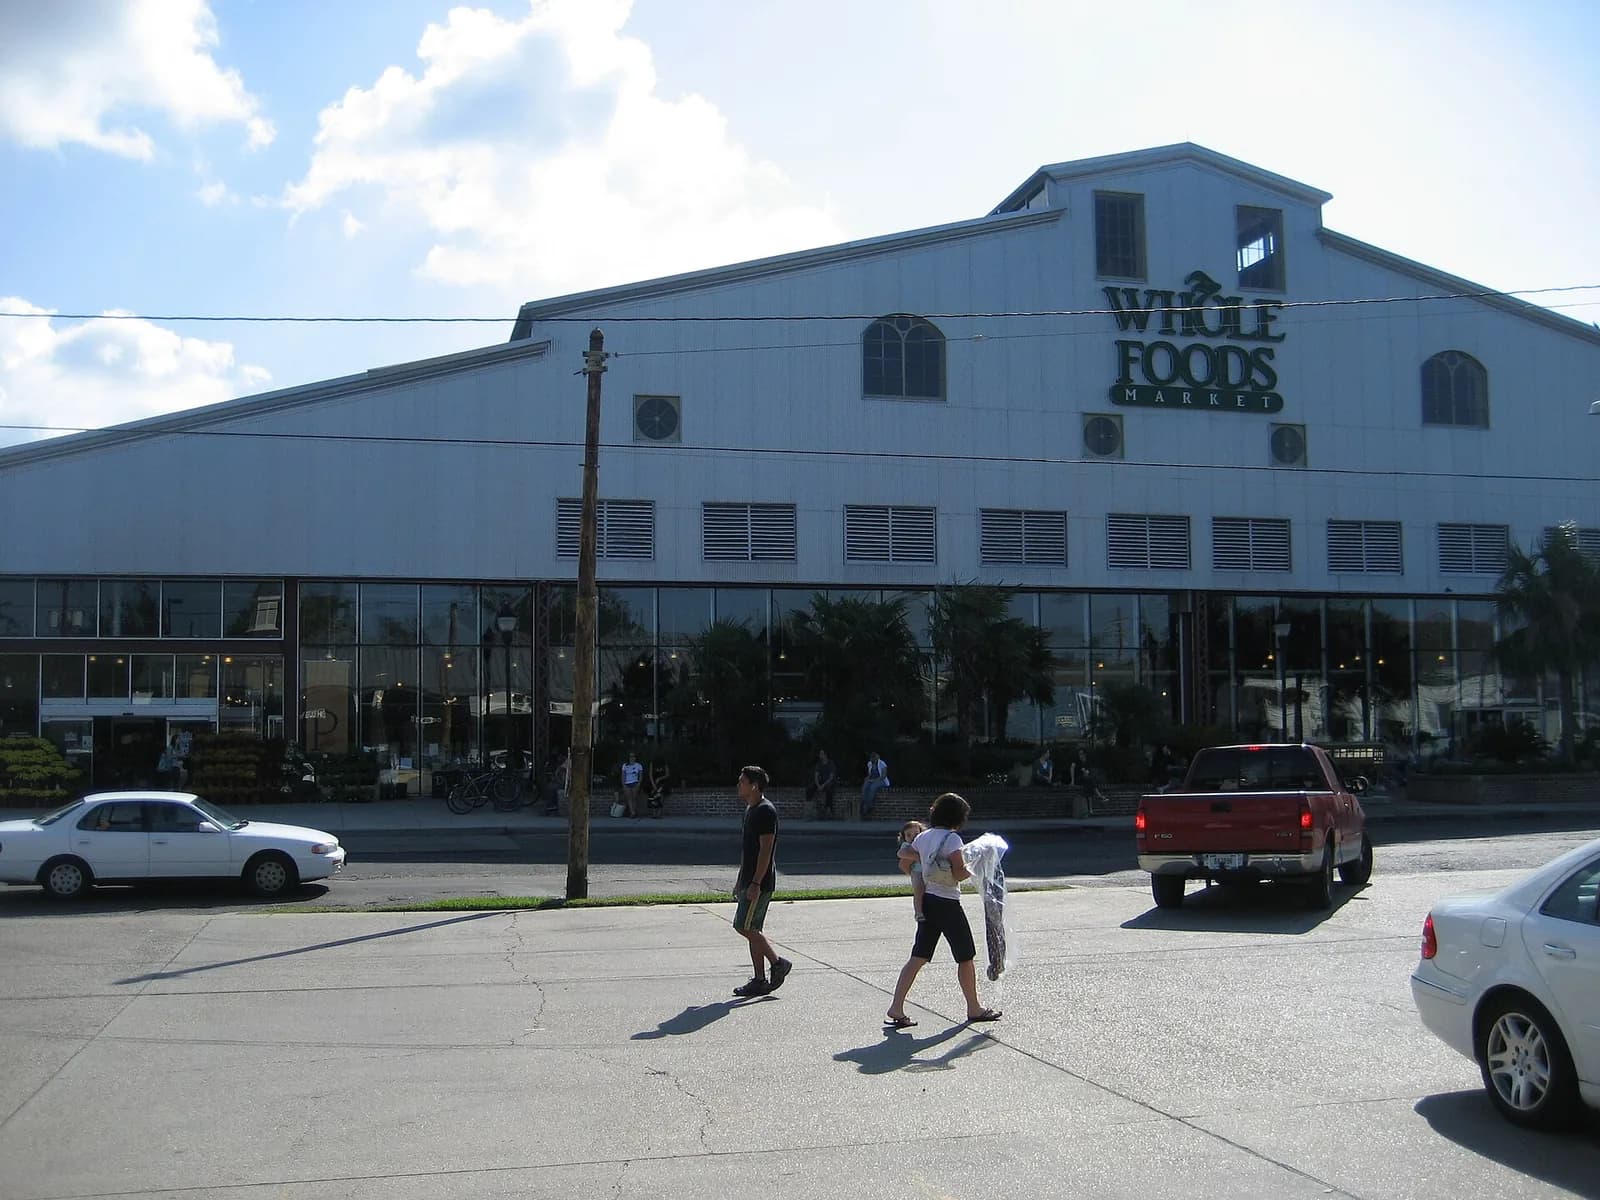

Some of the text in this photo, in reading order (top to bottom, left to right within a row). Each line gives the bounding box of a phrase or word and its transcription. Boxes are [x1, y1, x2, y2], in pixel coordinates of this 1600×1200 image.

[1102, 286, 1286, 342] WHOLE
[1114, 340, 1278, 391] FOODS
[1125, 388, 1271, 408] MARKET
